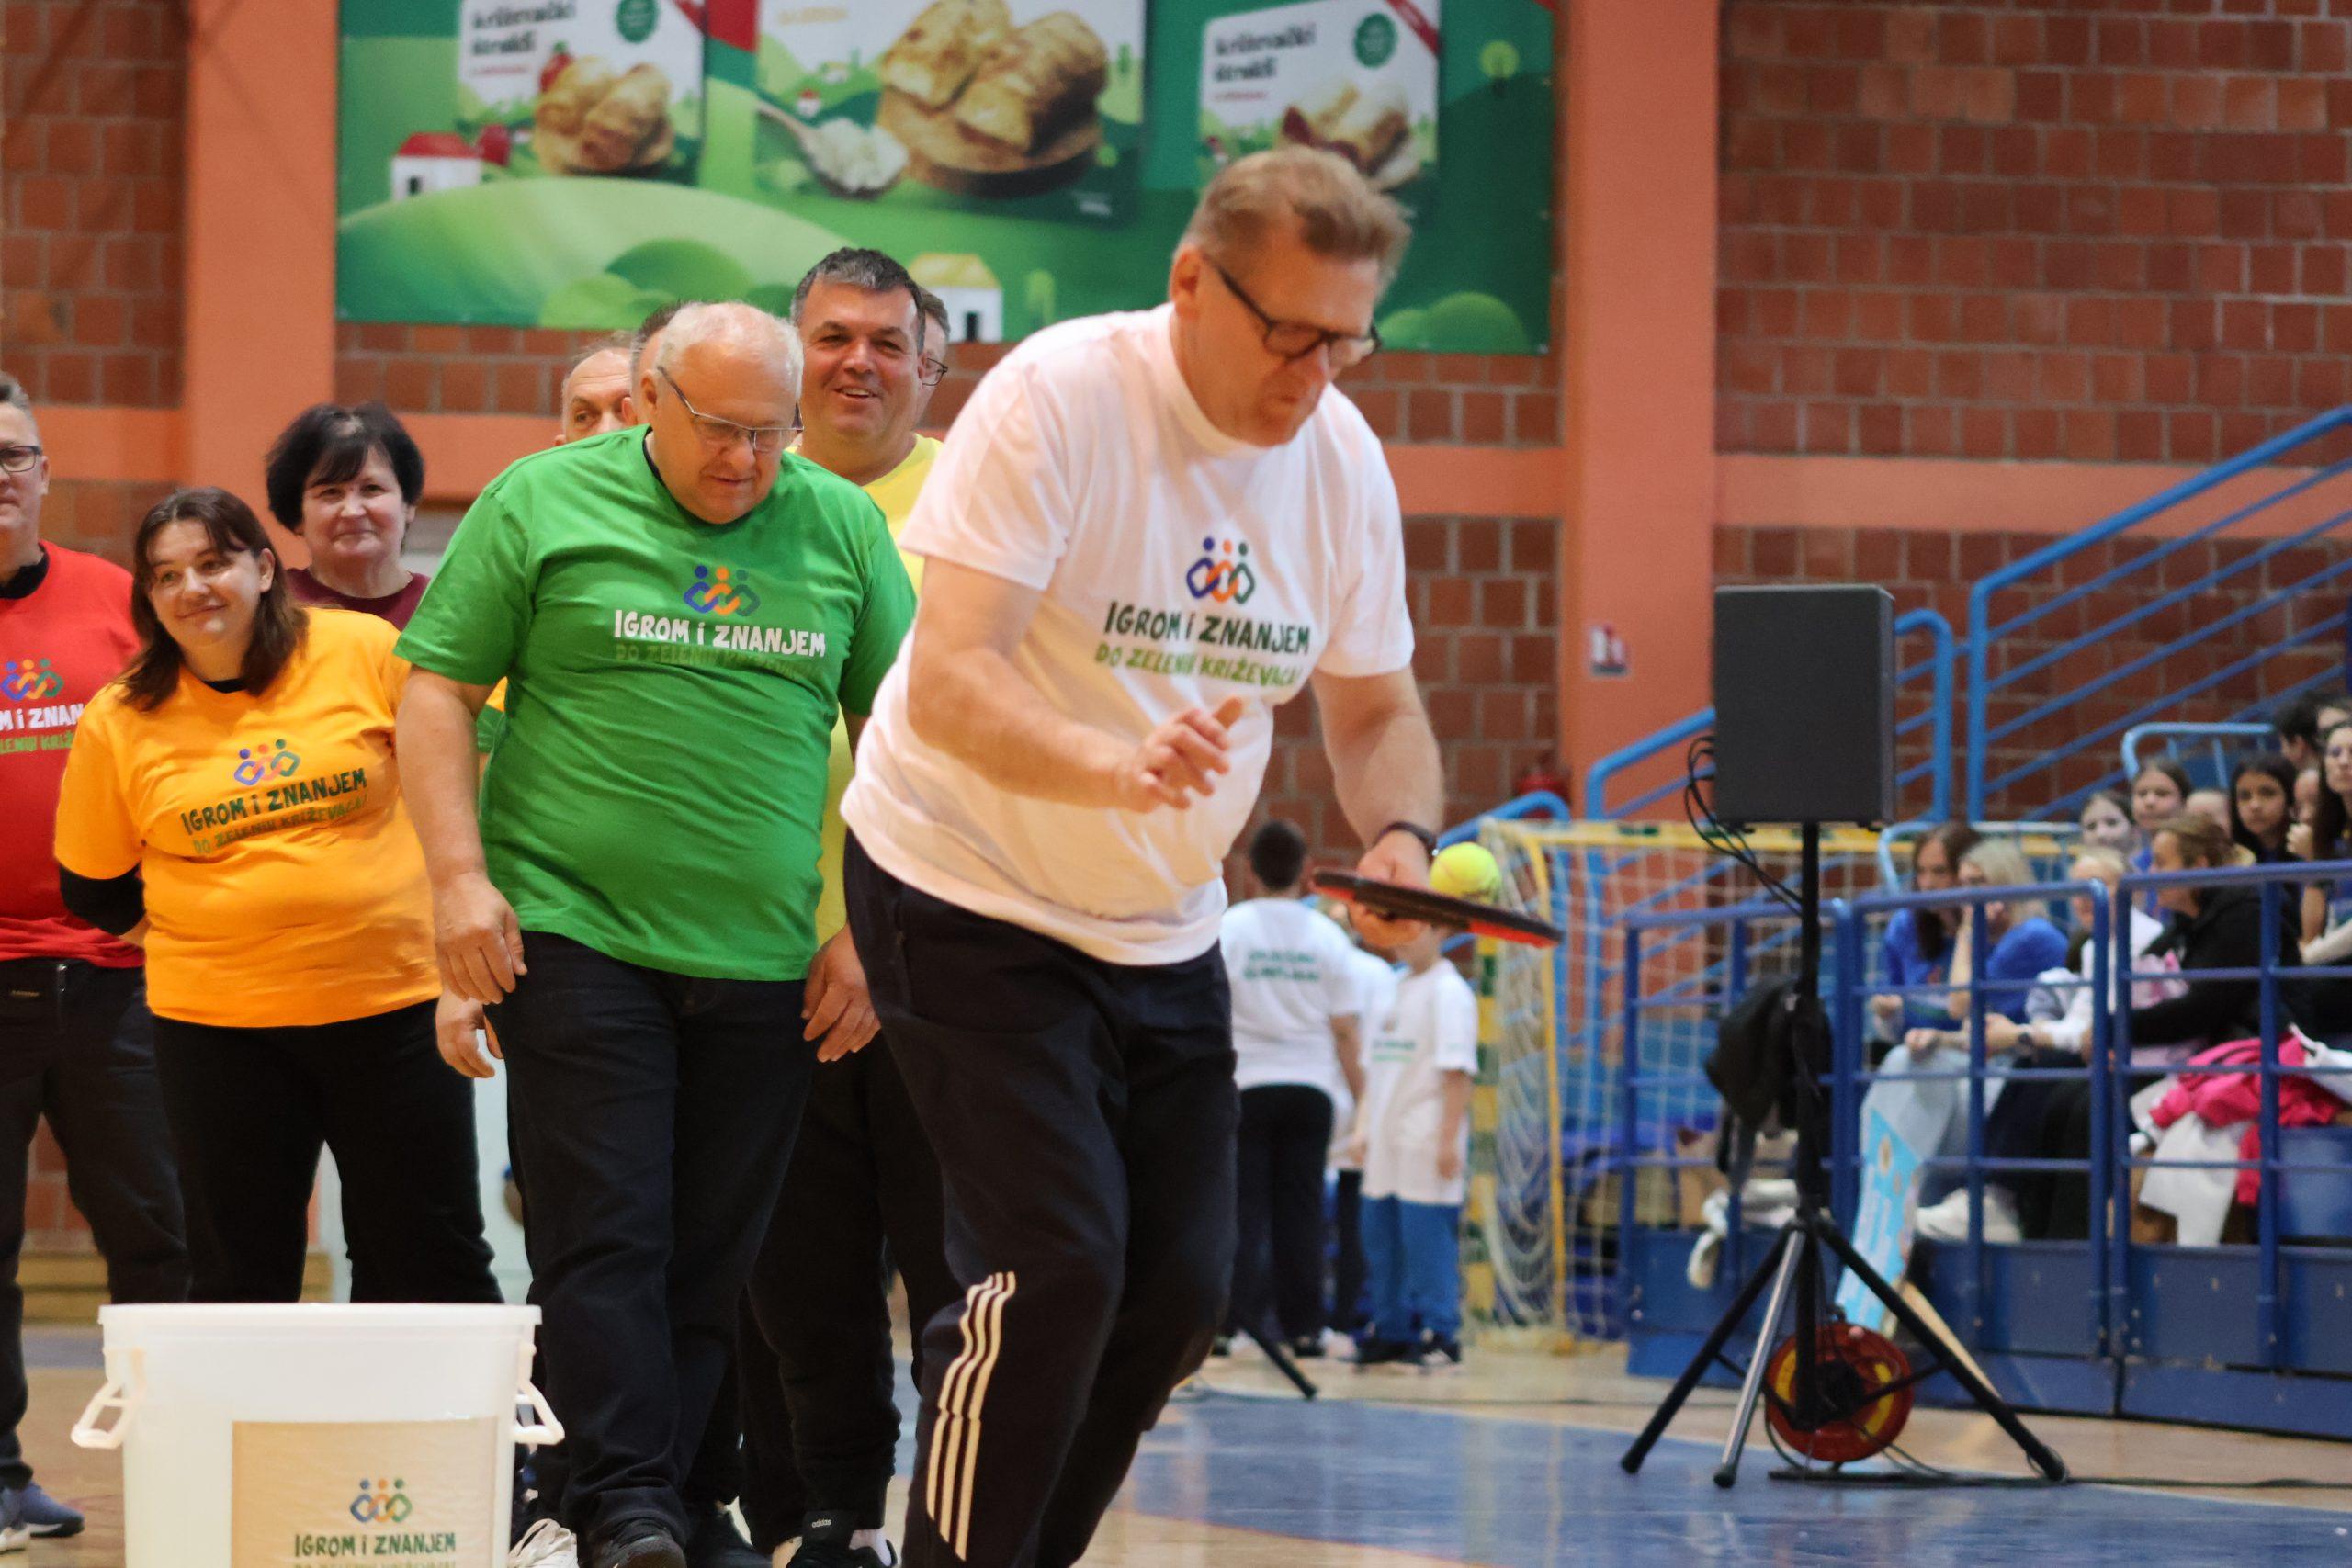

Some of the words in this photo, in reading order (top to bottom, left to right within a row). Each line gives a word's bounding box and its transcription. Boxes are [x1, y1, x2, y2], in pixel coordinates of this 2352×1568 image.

[614, 609, 690, 643] IGROM
[712, 624, 826, 658] ZNANJEM
[1104, 601, 1182, 640] IGROM
[1198, 615, 1310, 654] ZNANJEM
[1095, 641, 1123, 667] DO
[180, 797, 249, 836] IGROM
[266, 768, 368, 812] ZNANJEM
[192, 838, 213, 854] DO
[294, 1533, 356, 1558] IGROM
[373, 1531, 457, 1556] ZNANJEM
